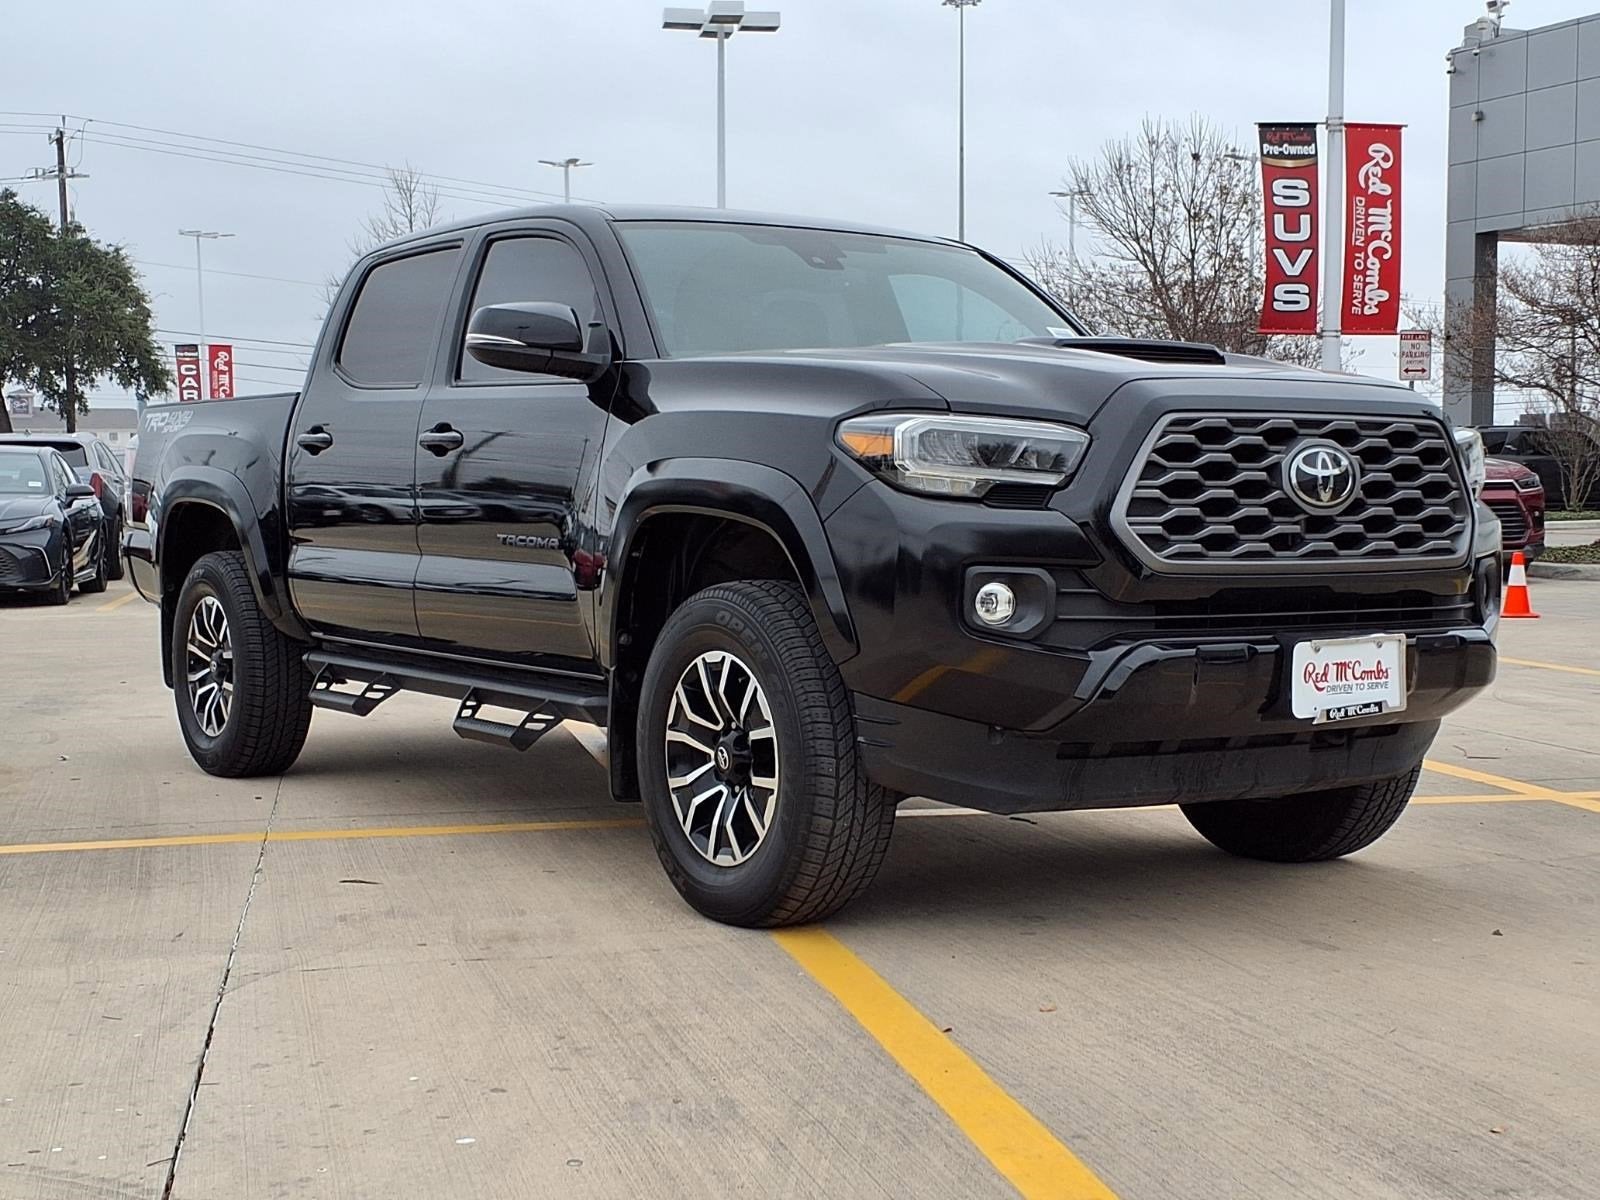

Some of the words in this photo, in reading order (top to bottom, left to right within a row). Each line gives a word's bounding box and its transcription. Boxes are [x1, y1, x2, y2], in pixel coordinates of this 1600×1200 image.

[1262, 143, 1316, 155] Pre-Owned
[1359, 143, 1393, 195] Red
[1354, 196, 1365, 246] DRIVEN
[1271, 178, 1313, 312] SUVS
[1353, 251, 1365, 270] TO
[1365, 200, 1392, 315] McCombs
[1352, 274, 1364, 315] SERVE
[145, 412, 170, 432] TRD
[496, 533, 560, 550] TACOMA
[1304, 662, 1329, 692] Red
[1332, 660, 1389, 682] McCombs
[1326, 683, 1354, 694] DRIVEN
[1355, 682, 1366, 691] TO
[1366, 680, 1389, 691] SERVE
